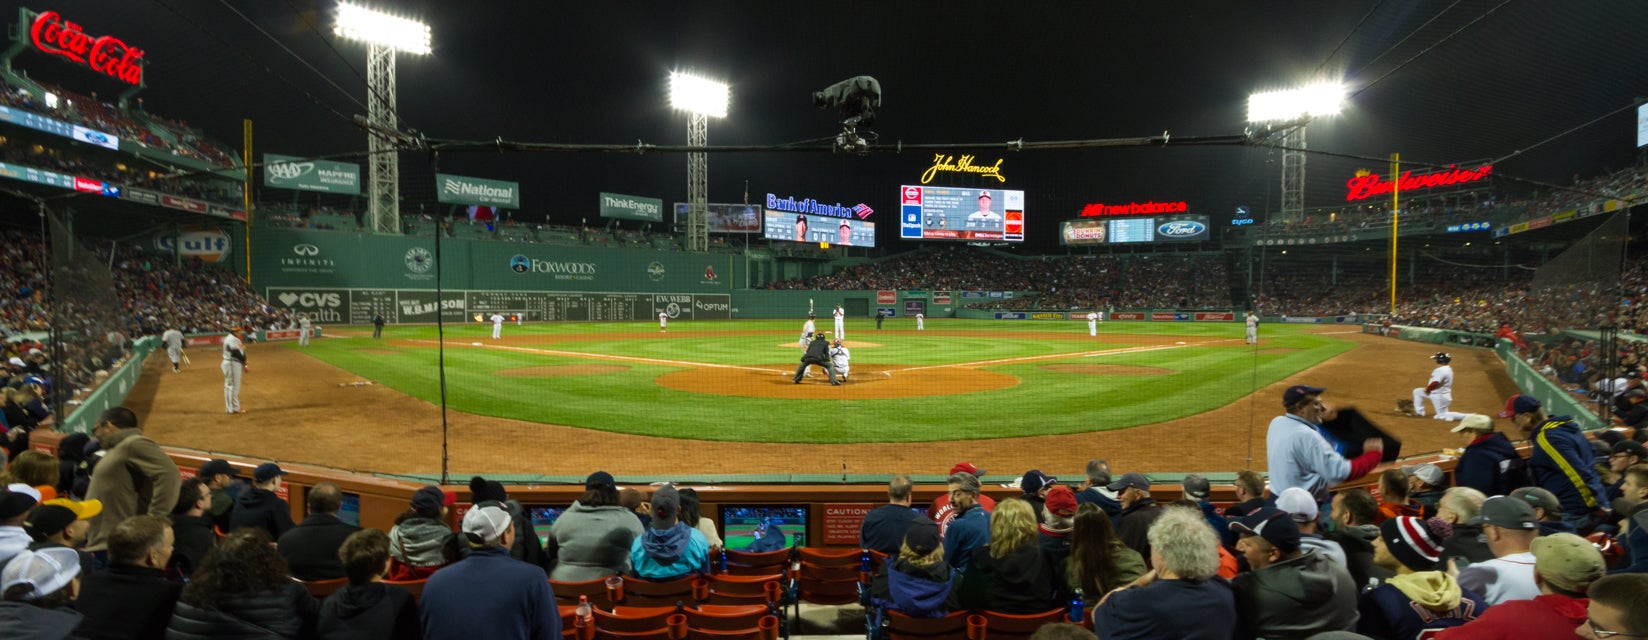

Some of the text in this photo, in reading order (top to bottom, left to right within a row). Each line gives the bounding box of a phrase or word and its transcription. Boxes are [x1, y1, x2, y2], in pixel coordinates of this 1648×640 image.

[31, 10, 145, 85] Coca-Cola
[318, 169, 357, 181] MAPFRE
[921, 153, 1006, 184] John Hancock
[460, 182, 514, 198] National
[1346, 164, 1493, 201] Budweiser
[766, 192, 852, 219] Bank of America
[1166, 223, 1196, 235] Ford
[281, 258, 335, 267] INFINITI
[532, 259, 596, 274] FOXWOODS
[299, 292, 341, 307] CVS
[704, 303, 728, 311] OPTUM
